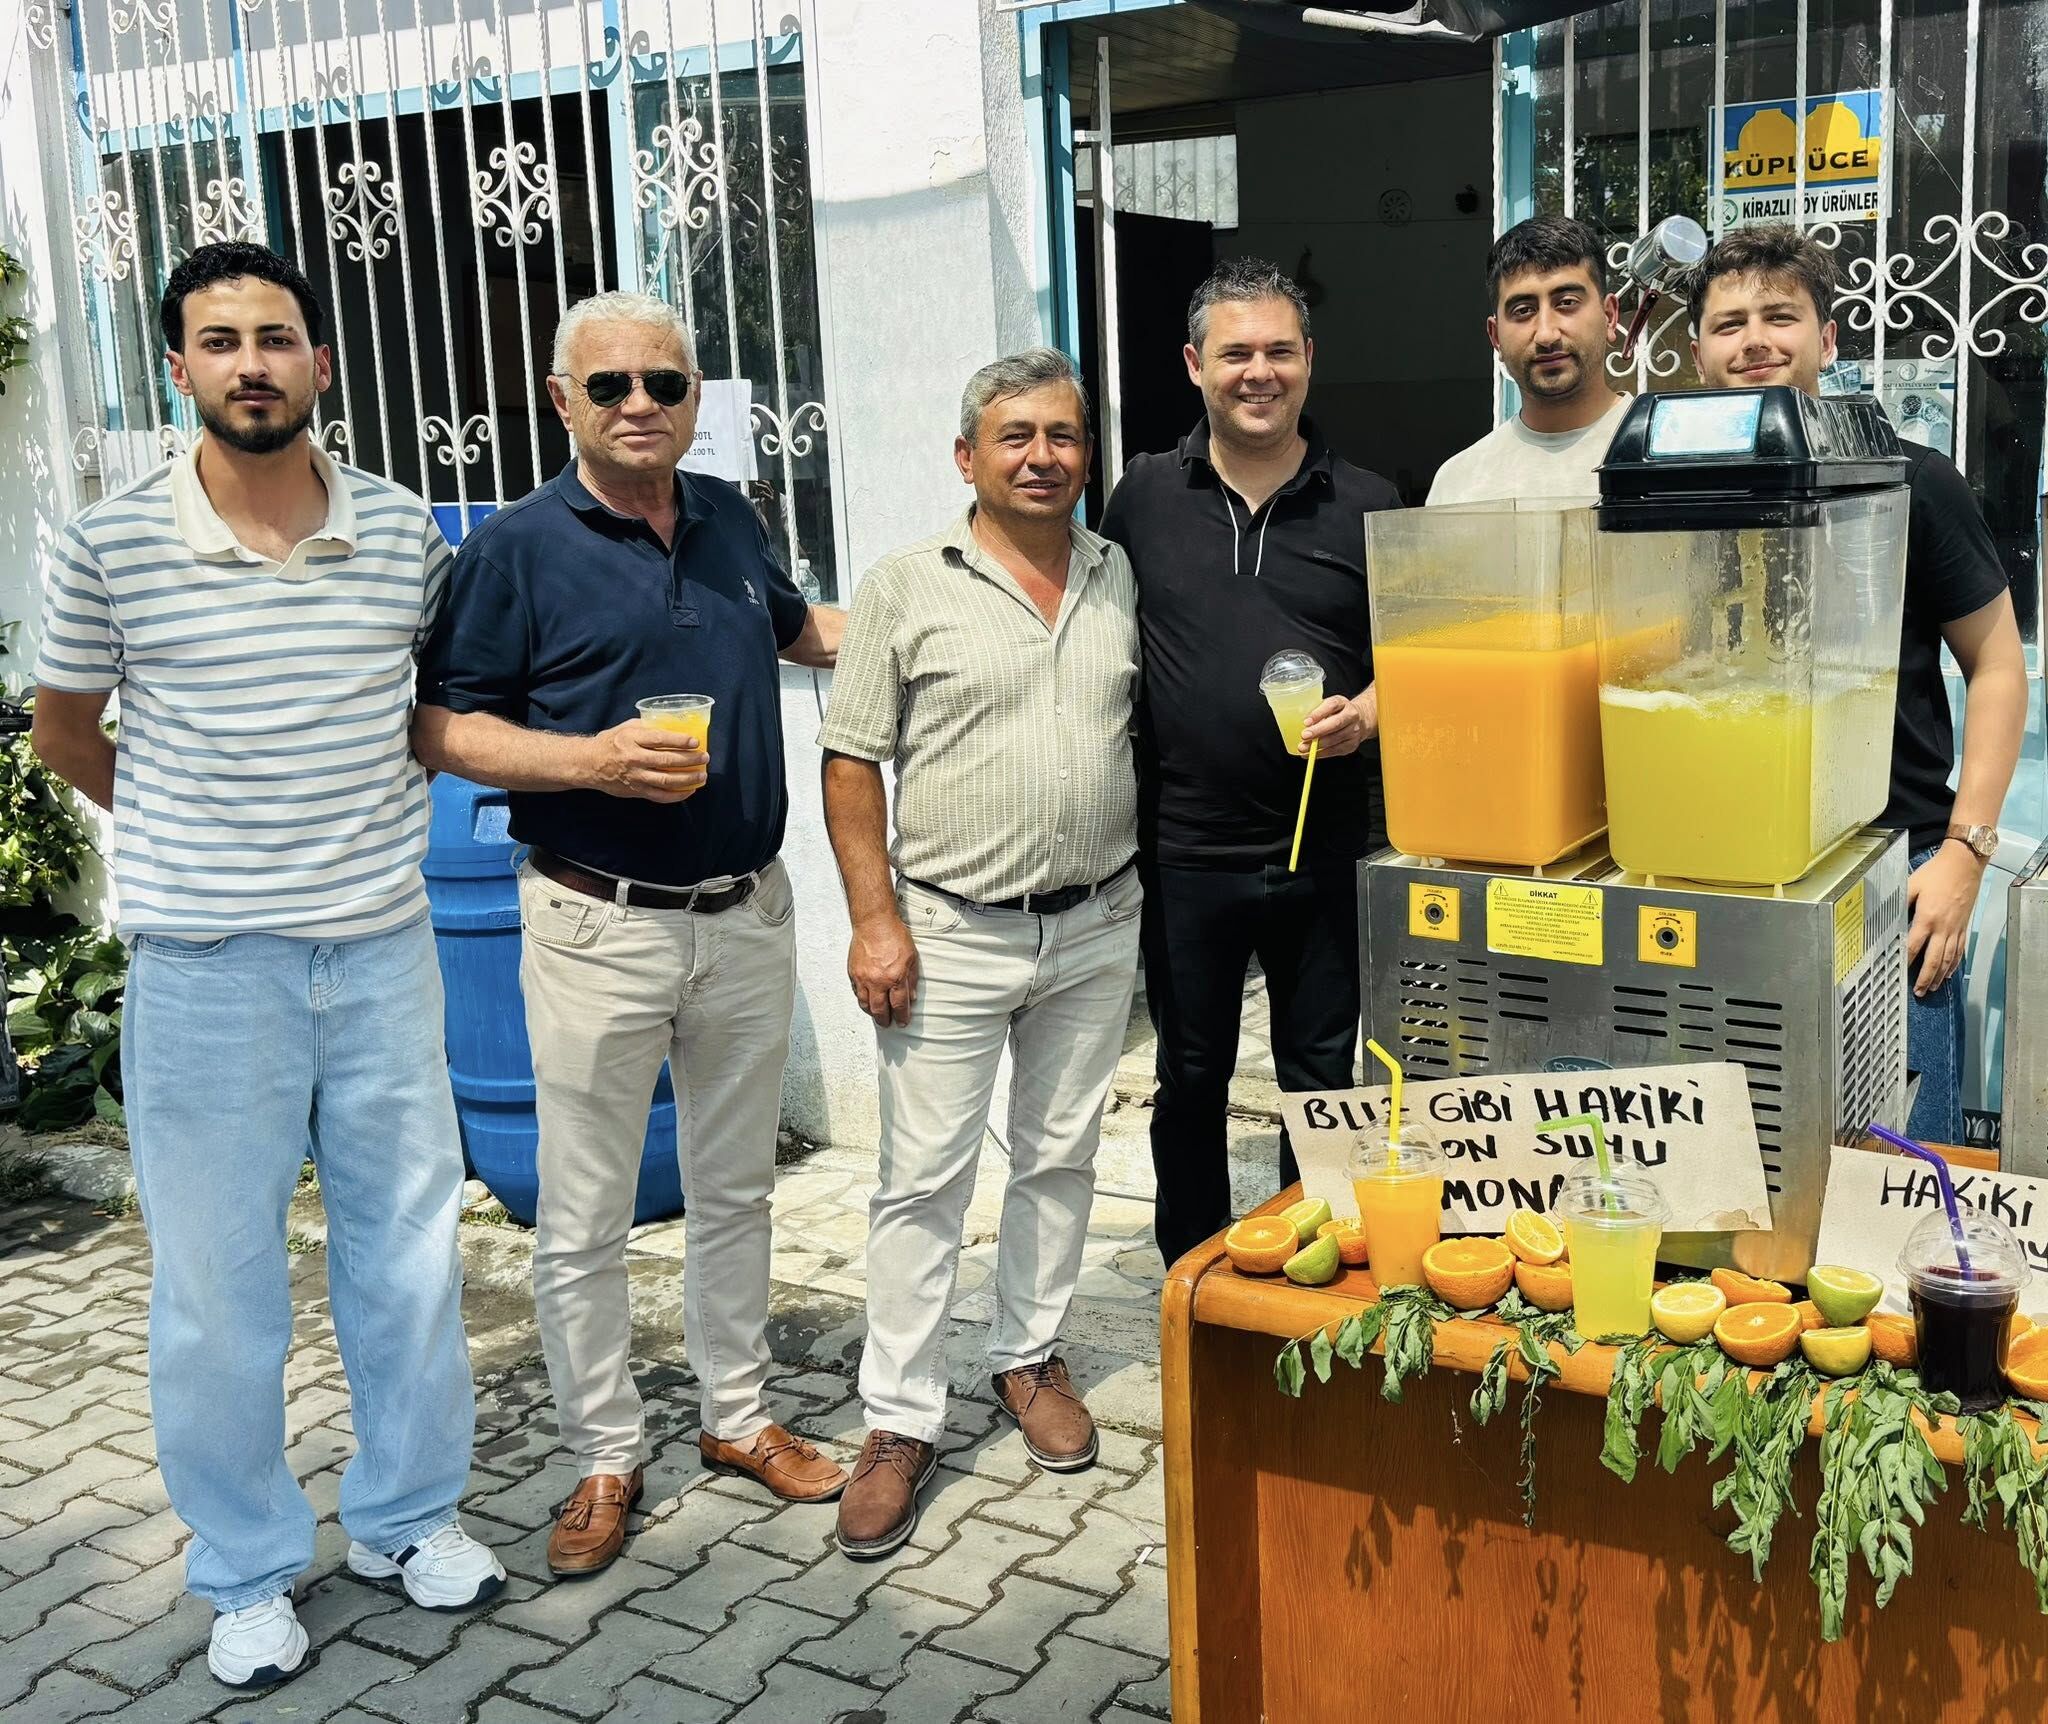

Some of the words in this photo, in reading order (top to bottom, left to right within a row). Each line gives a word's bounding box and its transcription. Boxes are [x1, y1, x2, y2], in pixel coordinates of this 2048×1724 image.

[1742, 197, 1791, 218] KİRAZLI
[1793, 193, 1819, 214] ÖY
[1822, 189, 1878, 213] ÜRÜNLER
[1529, 890, 1558, 899] DİKKAT
[1429, 1083, 1512, 1123] GİBİ
[1533, 1079, 1704, 1129] HAKİKİ
[1880, 1166, 2037, 1228] HAKİKİ
